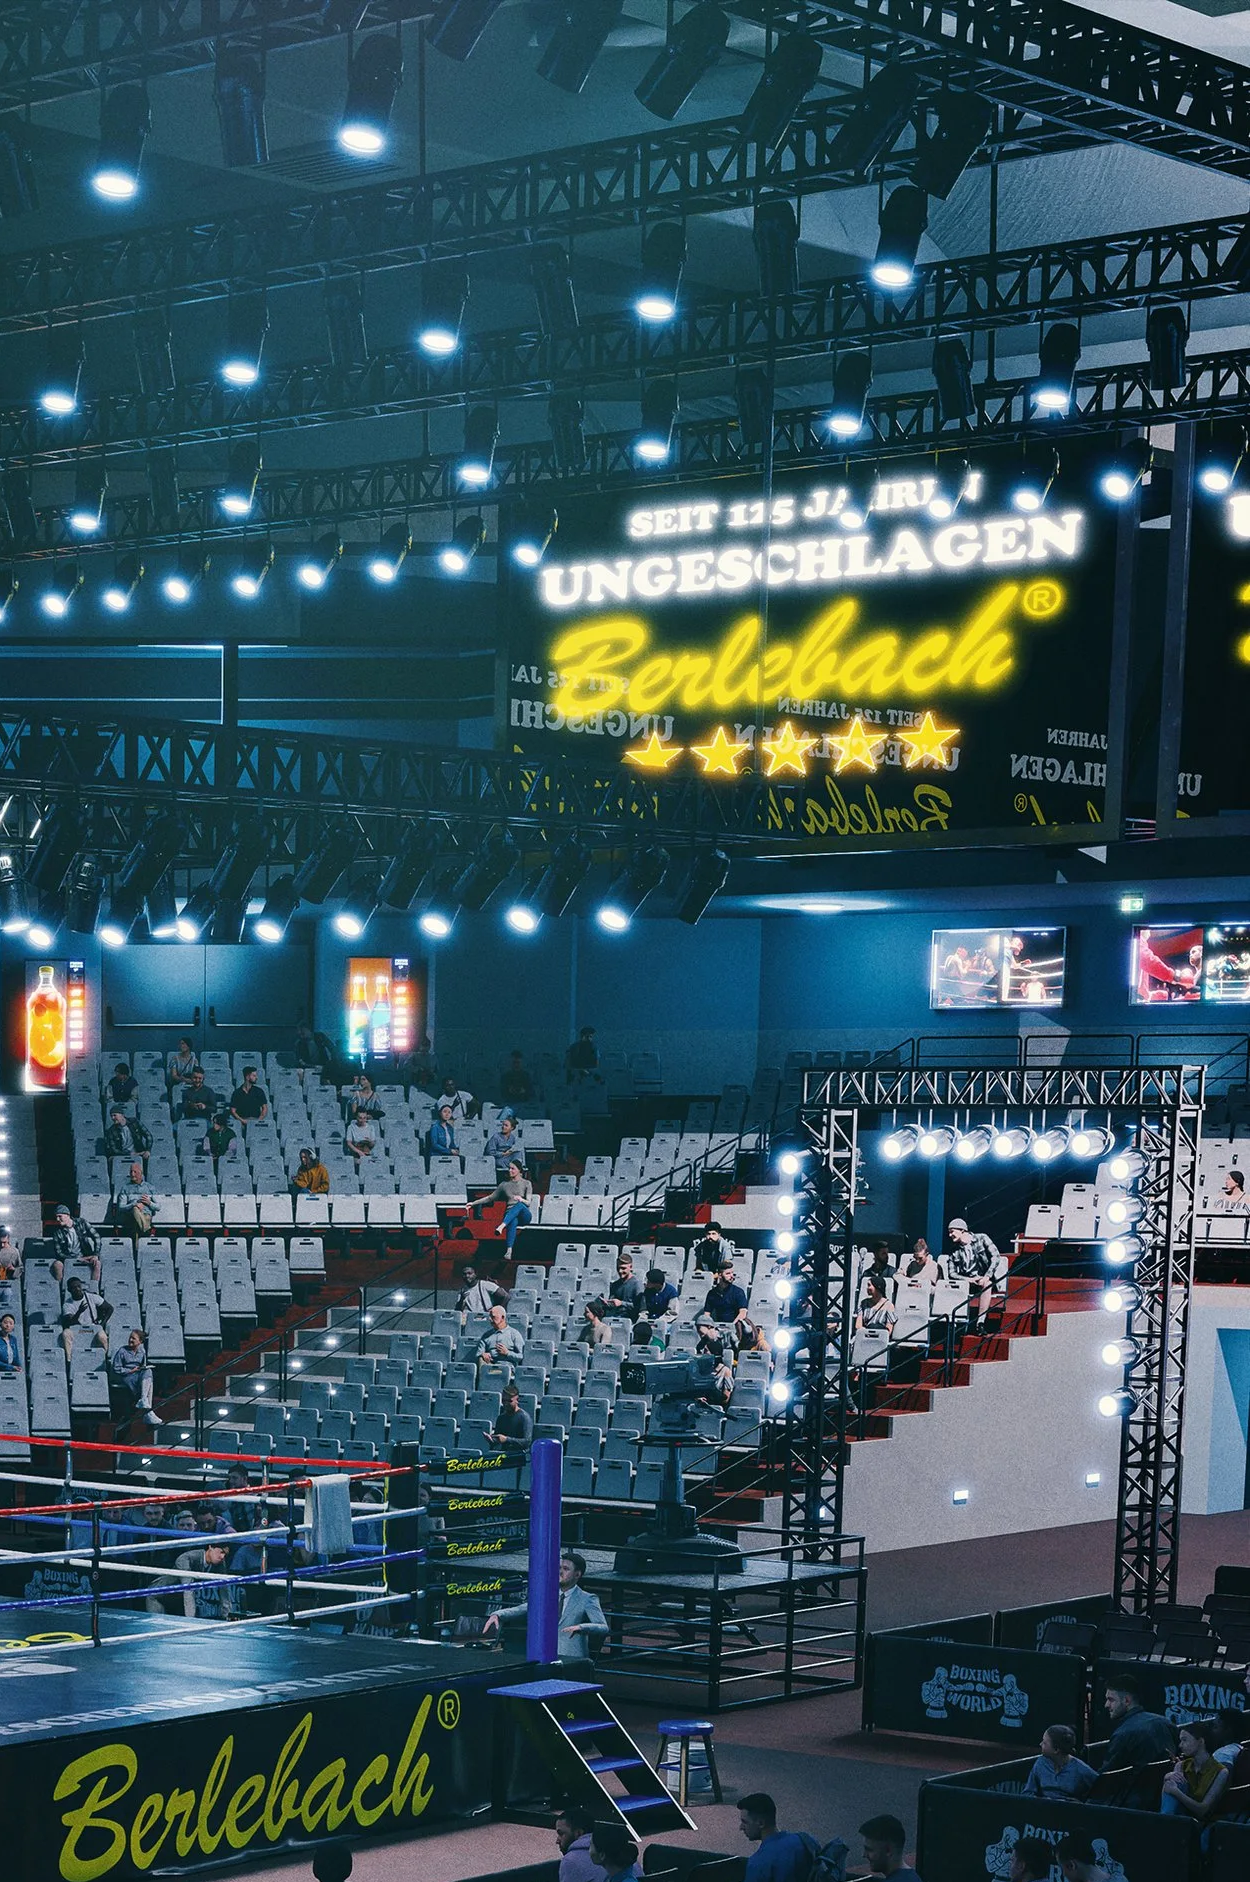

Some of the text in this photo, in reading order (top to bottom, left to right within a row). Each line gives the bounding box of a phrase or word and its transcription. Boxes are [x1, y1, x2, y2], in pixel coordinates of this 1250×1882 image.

[629, 504, 719, 537] SEIT
[542, 512, 1084, 606] UNGESCHLAGEN
[950, 1663, 1000, 1684] BOXING
[947, 1691, 1003, 1713] WORLD
[1164, 1683, 1245, 1712] BOXING
